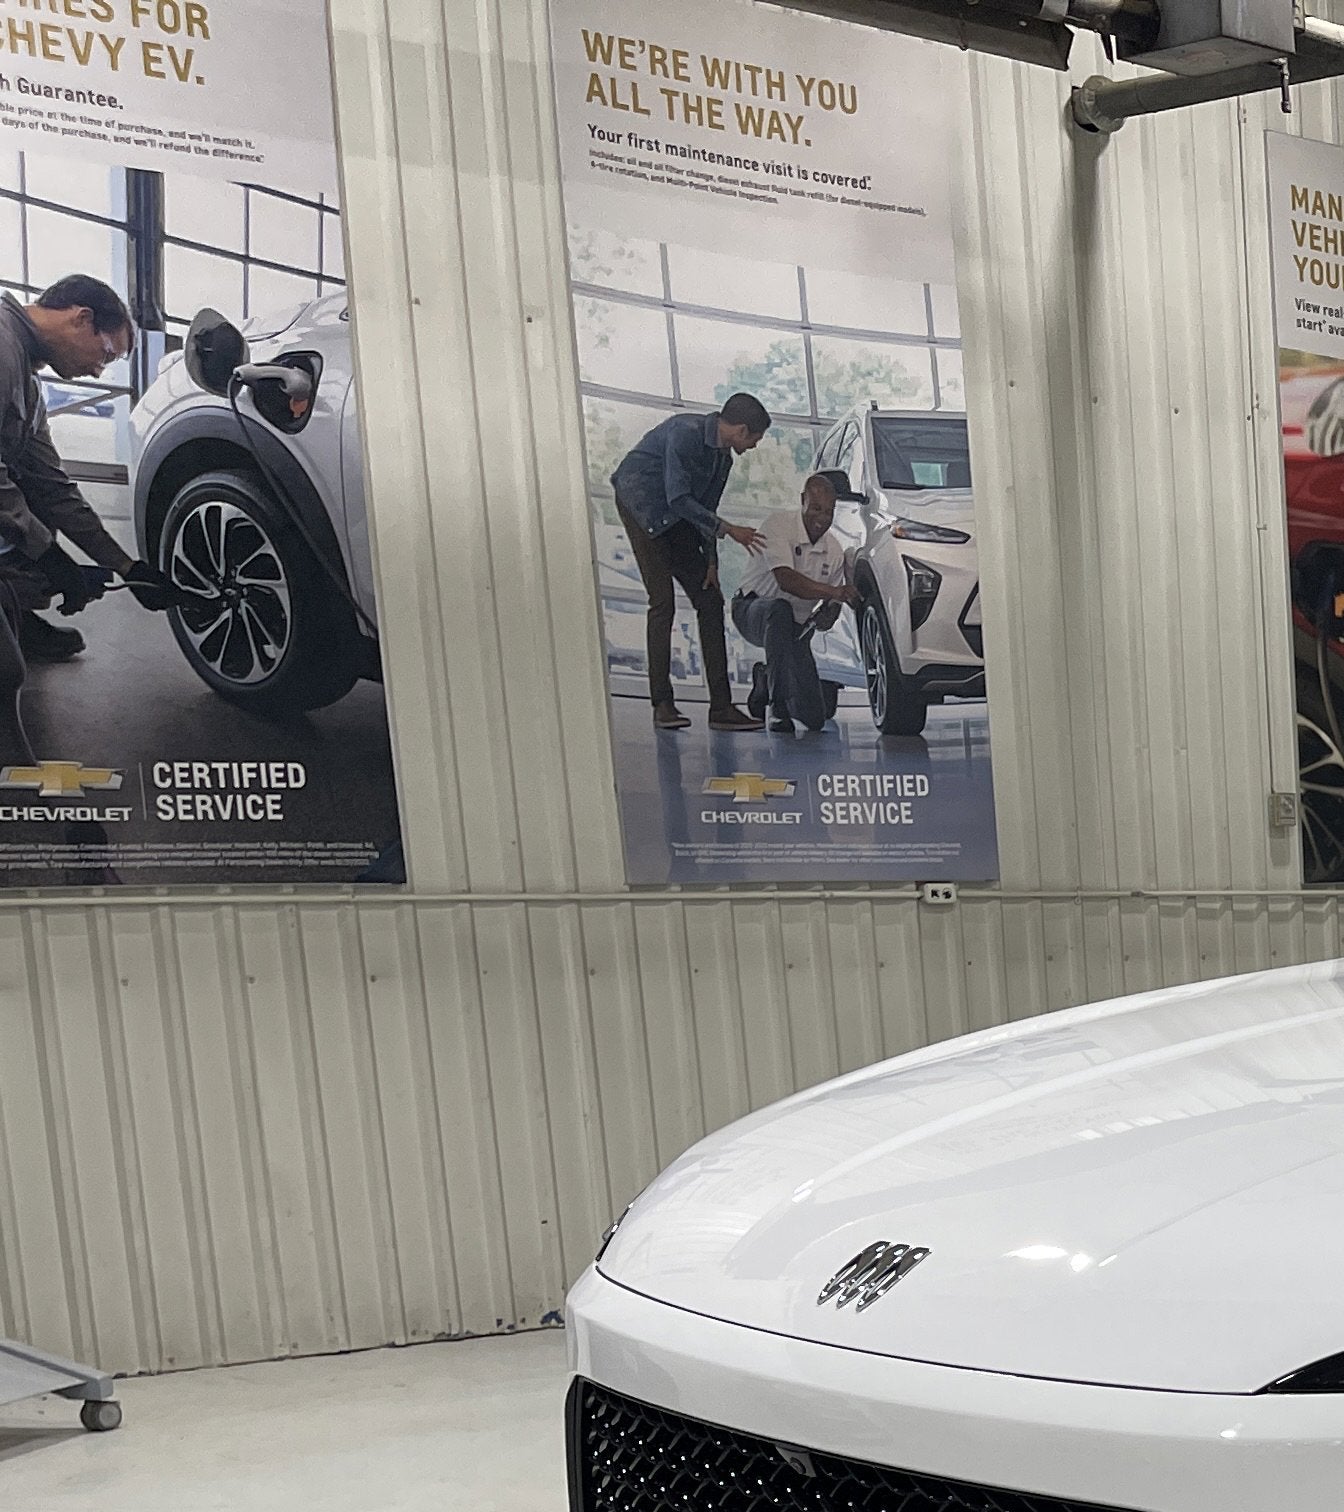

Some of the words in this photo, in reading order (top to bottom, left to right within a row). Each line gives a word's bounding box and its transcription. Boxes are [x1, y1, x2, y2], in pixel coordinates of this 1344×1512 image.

[131, 0, 210, 40] FOR
[0, 17, 126, 71] HEVY
[142, 41, 206, 85] EV.
[581, 28, 692, 83] WE'RE
[700, 54, 787, 102] WITH
[795, 73, 858, 115] YOU
[17, 77, 124, 110] Guarantee.
[60, 112, 77, 123] the
[80, 114, 102, 127] time
[105, 119, 115, 129] of
[585, 72, 651, 117] ALL
[659, 87, 725, 132] THE
[734, 102, 813, 147] WAY.
[29, 121, 40, 131] of
[42, 123, 59, 134] the
[587, 123, 623, 145] Your
[627, 131, 661, 153] first
[665, 142, 760, 173] maintenance
[762, 158, 793, 179] visit
[796, 164, 809, 181] is
[1295, 298, 1320, 315] View
[152, 761, 307, 790] CERTIFIED
[817, 774, 929, 797] CERTIFIED
[0, 806, 133, 822] CHEVROLET
[156, 793, 284, 822] SERVICE
[701, 811, 803, 825] CHEVROLET
[820, 802, 914, 825] SERVICE
